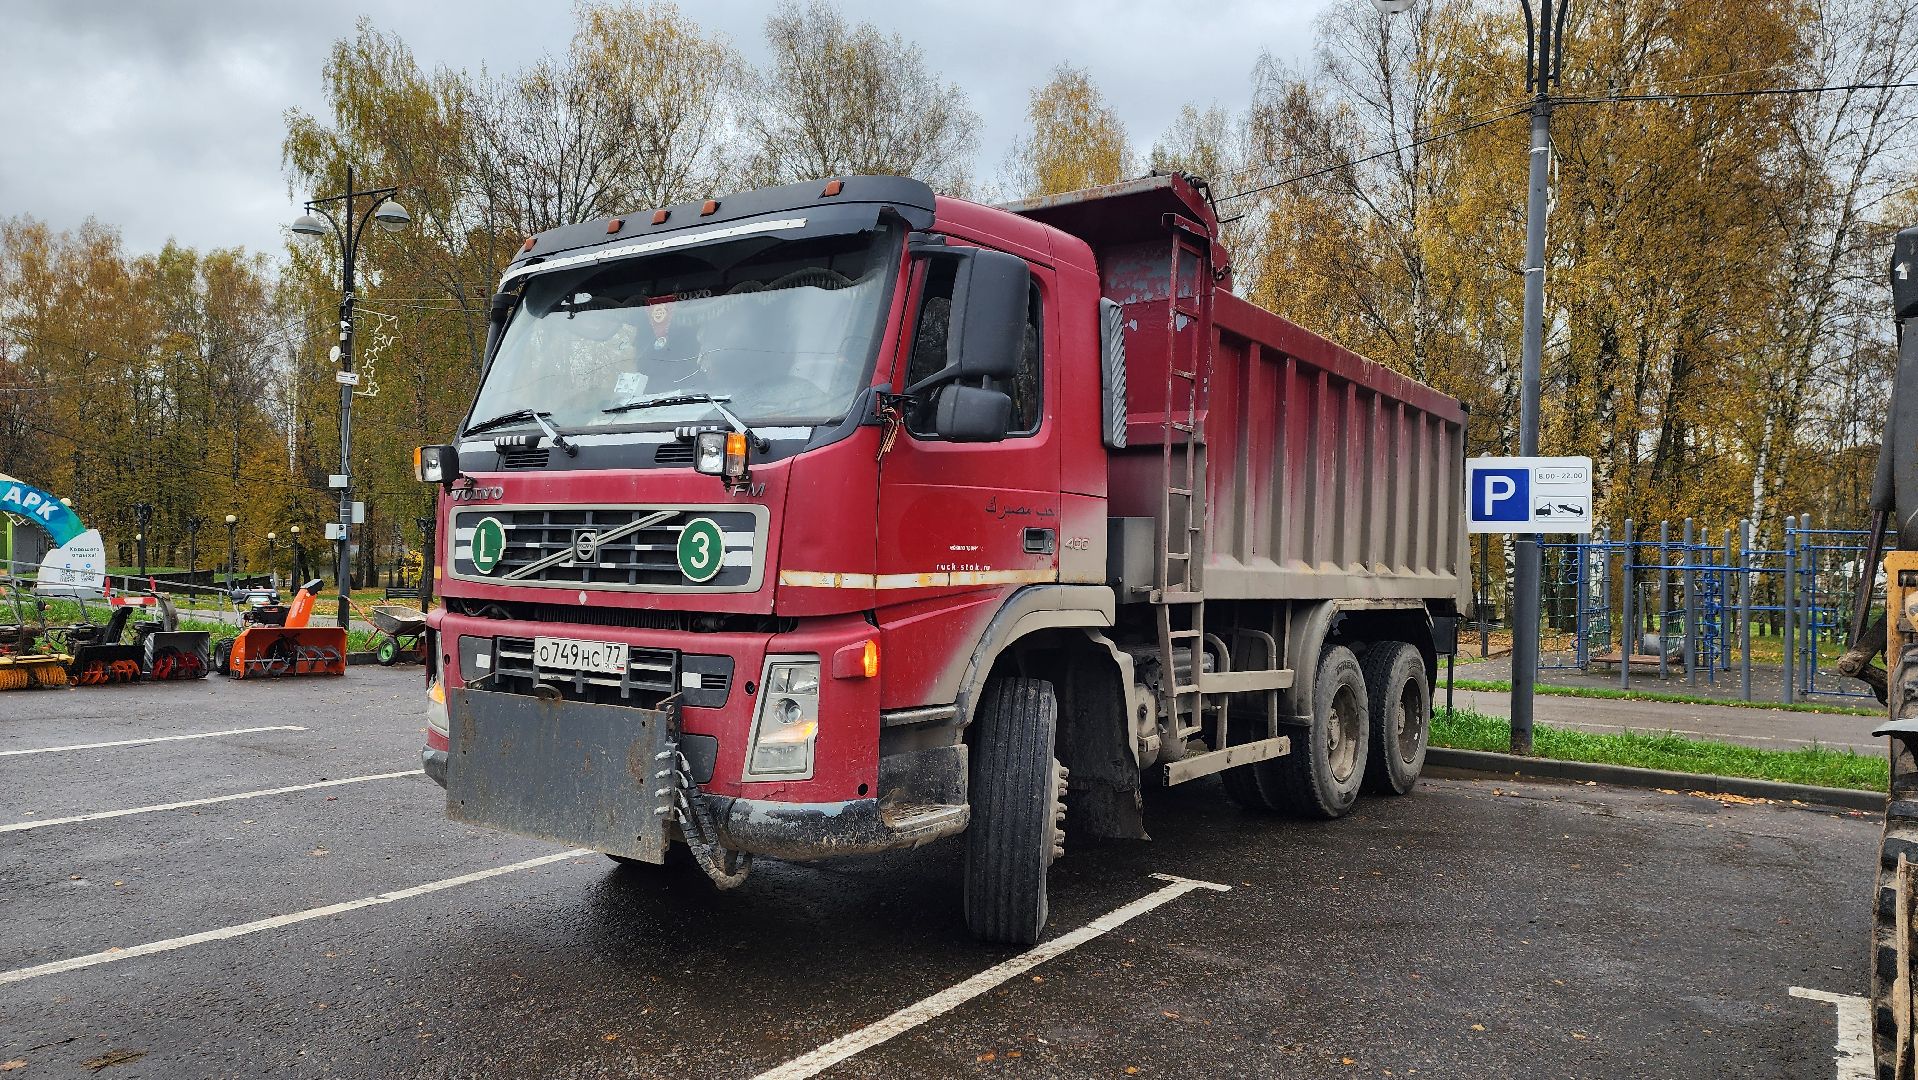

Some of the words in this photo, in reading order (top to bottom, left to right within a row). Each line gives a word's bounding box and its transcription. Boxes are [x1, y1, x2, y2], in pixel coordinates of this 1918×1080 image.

[451, 486, 504, 501] VOLVO
[732, 482, 766, 497] FM
[1484, 475, 1516, 516] P
[479, 528, 493, 563] L
[690, 531, 710, 569] 3
[605, 645, 621, 664] 77
